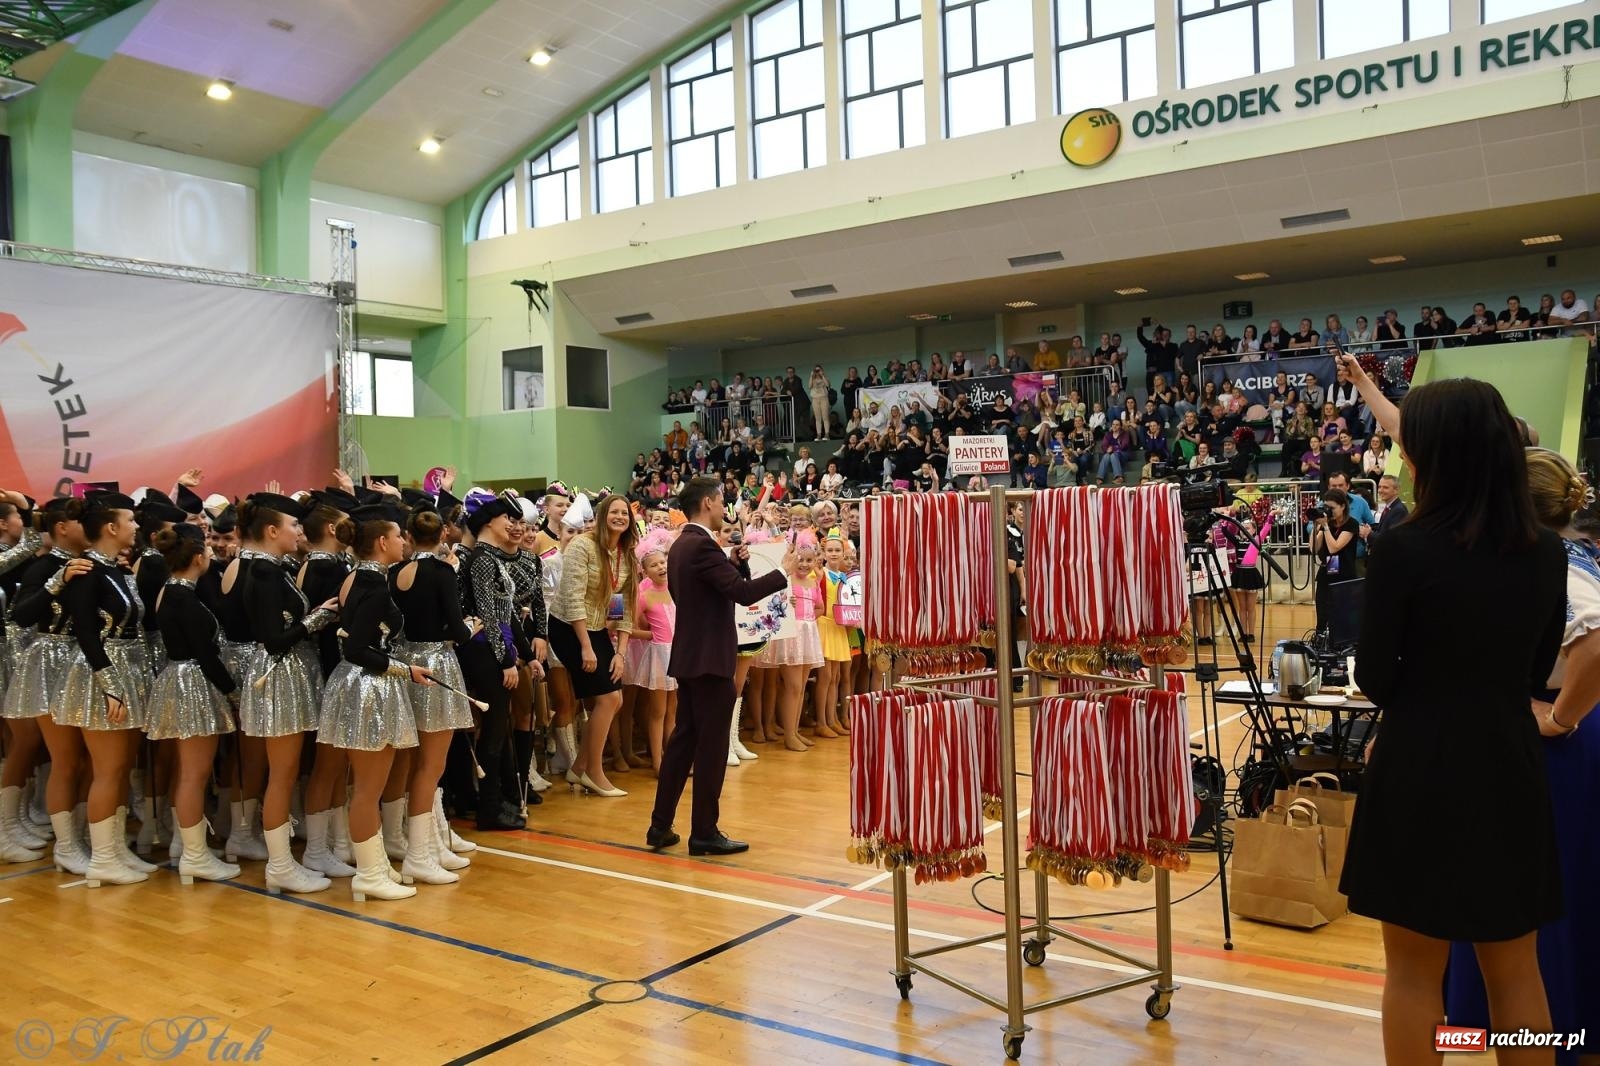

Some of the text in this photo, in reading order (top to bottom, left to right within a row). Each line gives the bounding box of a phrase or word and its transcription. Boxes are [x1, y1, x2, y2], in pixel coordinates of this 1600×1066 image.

[1131, 84, 1281, 139] OŚRODEK
[1294, 49, 1439, 108] SPORTU
[1453, 45, 1462, 77] I
[1230, 373, 1308, 391] ACIBRZ
[955, 446, 1004, 459] PANTERY
[954, 463, 979, 472] Gliwice
[984, 462, 1006, 471] Poland
